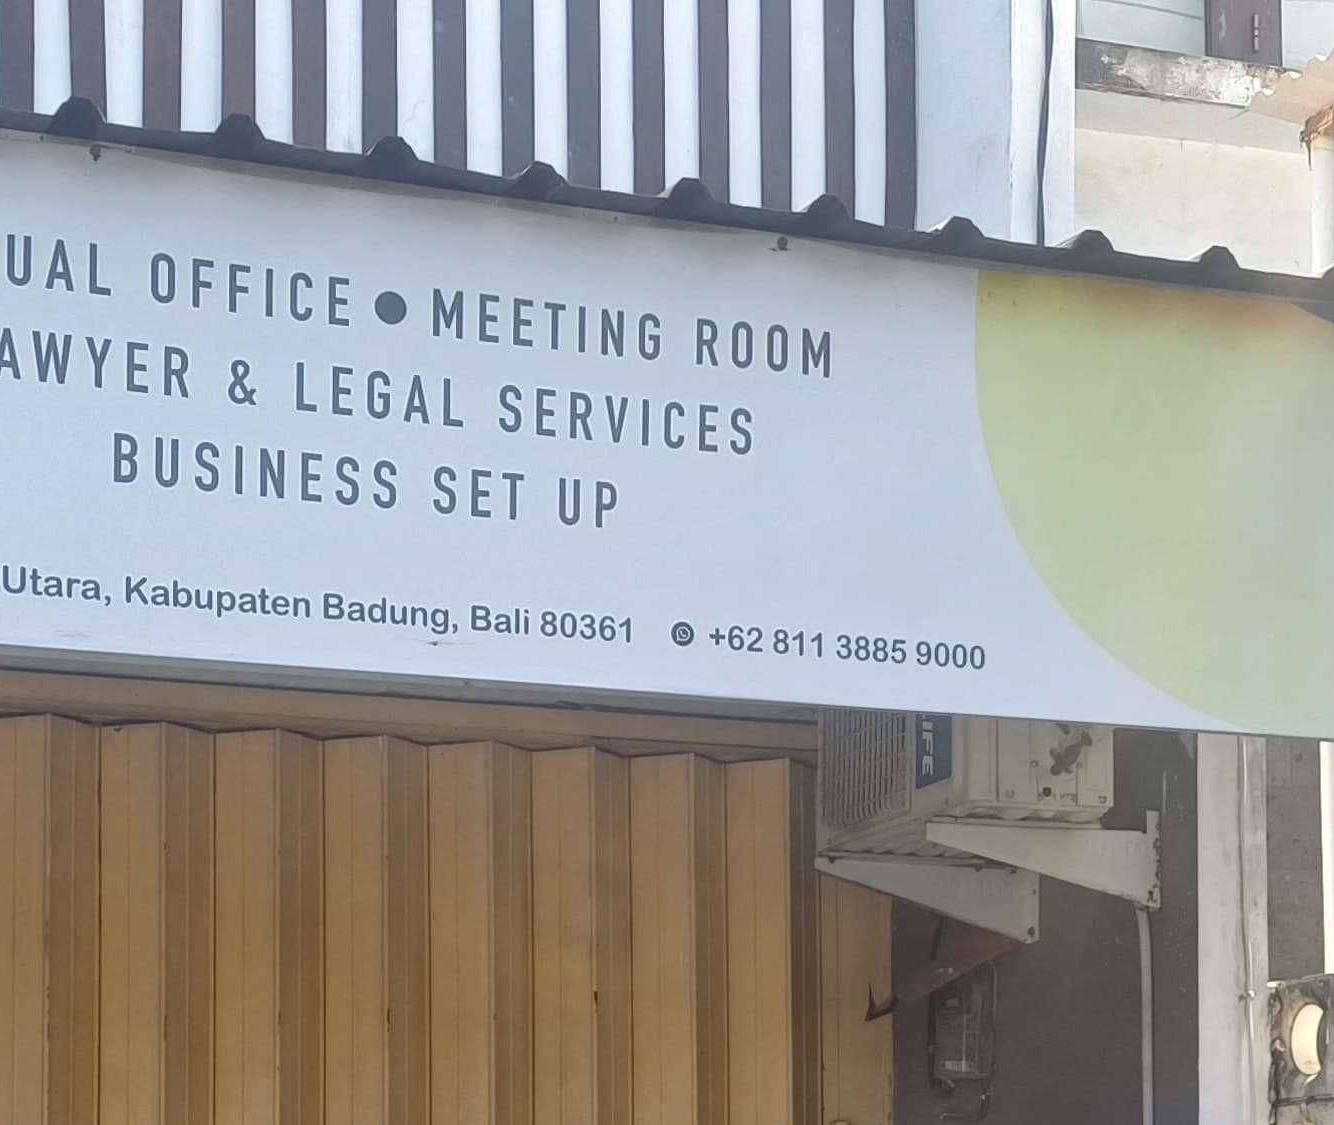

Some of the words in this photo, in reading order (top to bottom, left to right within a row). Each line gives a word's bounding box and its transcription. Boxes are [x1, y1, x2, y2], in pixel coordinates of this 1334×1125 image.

[151, 253, 349, 326] OFFICE
[433, 288, 660, 360] MEETING
[696, 318, 830, 378] ROOM
[228, 360, 256, 405] &
[296, 362, 463, 427] LEGAL
[499, 385, 751, 455] SERVICES
[114, 433, 397, 508] BUSINESS
[433, 466, 524, 520] SET
[559, 478, 617, 528] UP
[3, 565, 111, 606] Utara,
[126, 576, 310, 618] Kabupaten
[324, 593, 458, 634] Badung,
[471, 605, 529, 635] Bali
[541, 611, 631, 643] 80361
[709, 626, 763, 652] +62
[773, 629, 822, 658] 811
[836, 635, 906, 664] 3885
[916, 641, 985, 669] 9000
[922, 712, 933, 776] IFE
